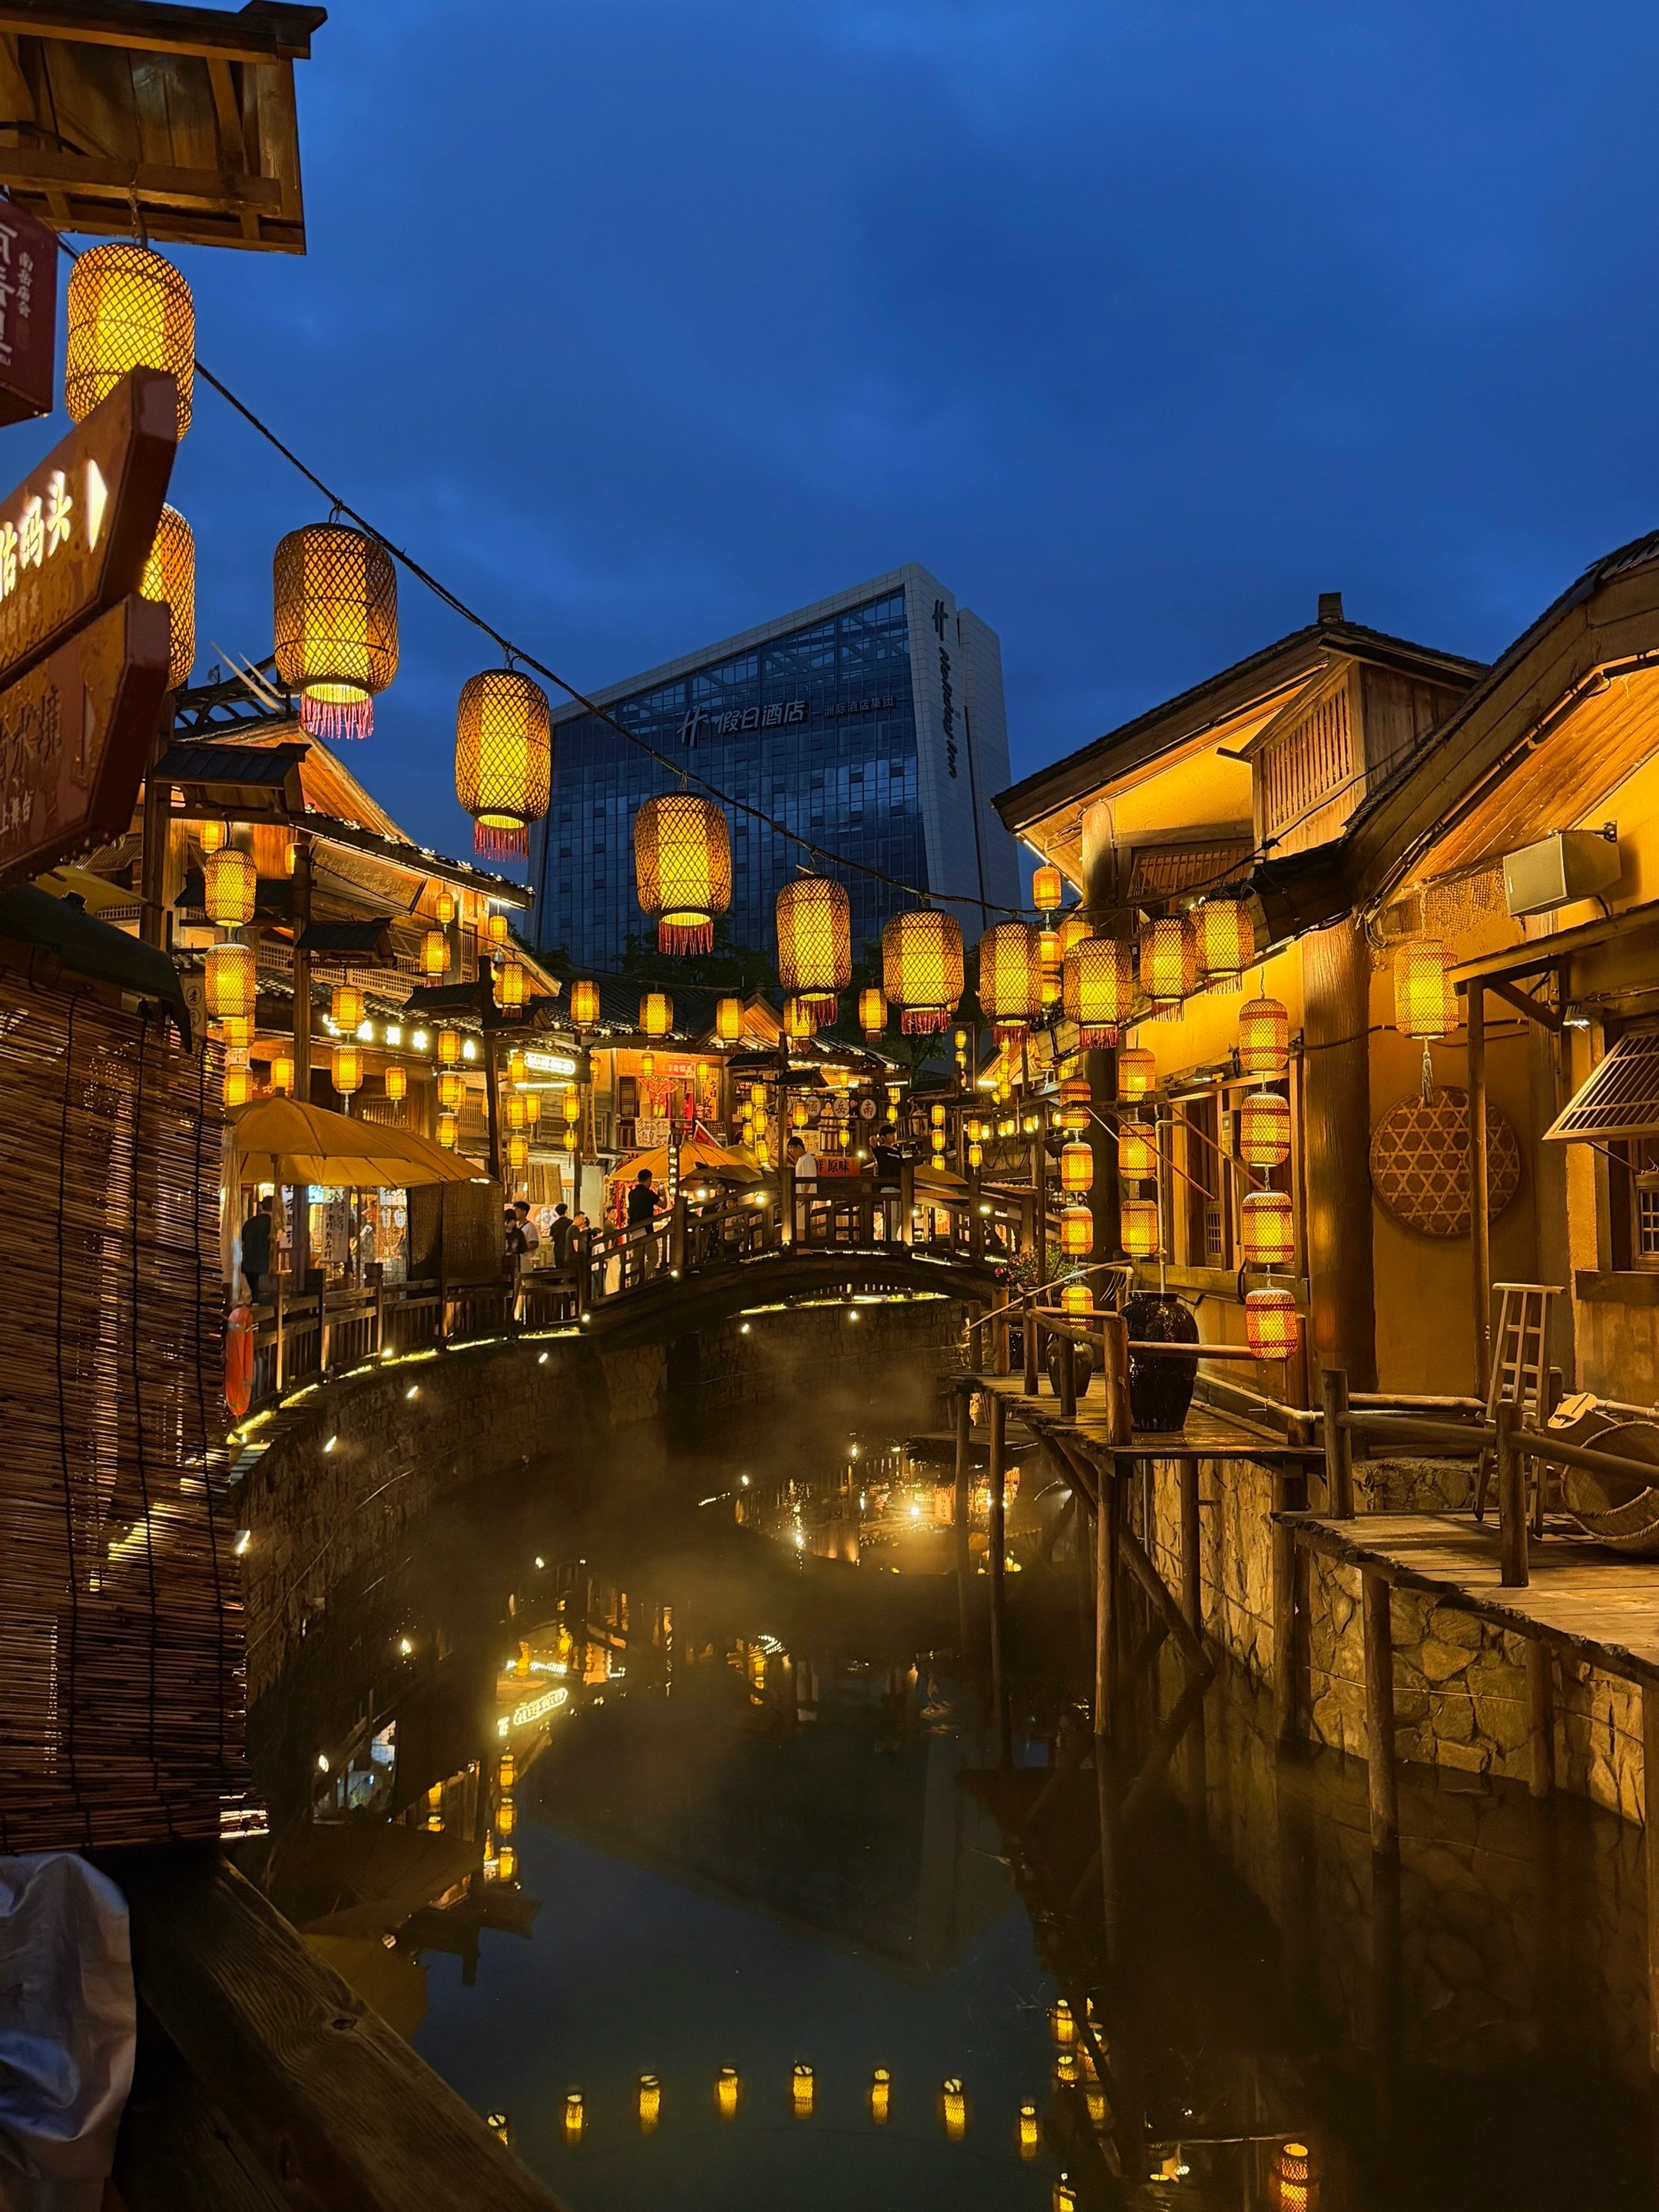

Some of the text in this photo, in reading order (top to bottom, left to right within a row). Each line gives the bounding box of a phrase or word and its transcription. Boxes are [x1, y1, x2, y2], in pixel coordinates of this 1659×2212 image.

[715, 699, 806, 734] 假日酒店
[824, 695, 894, 717] 洲际酒店集团
